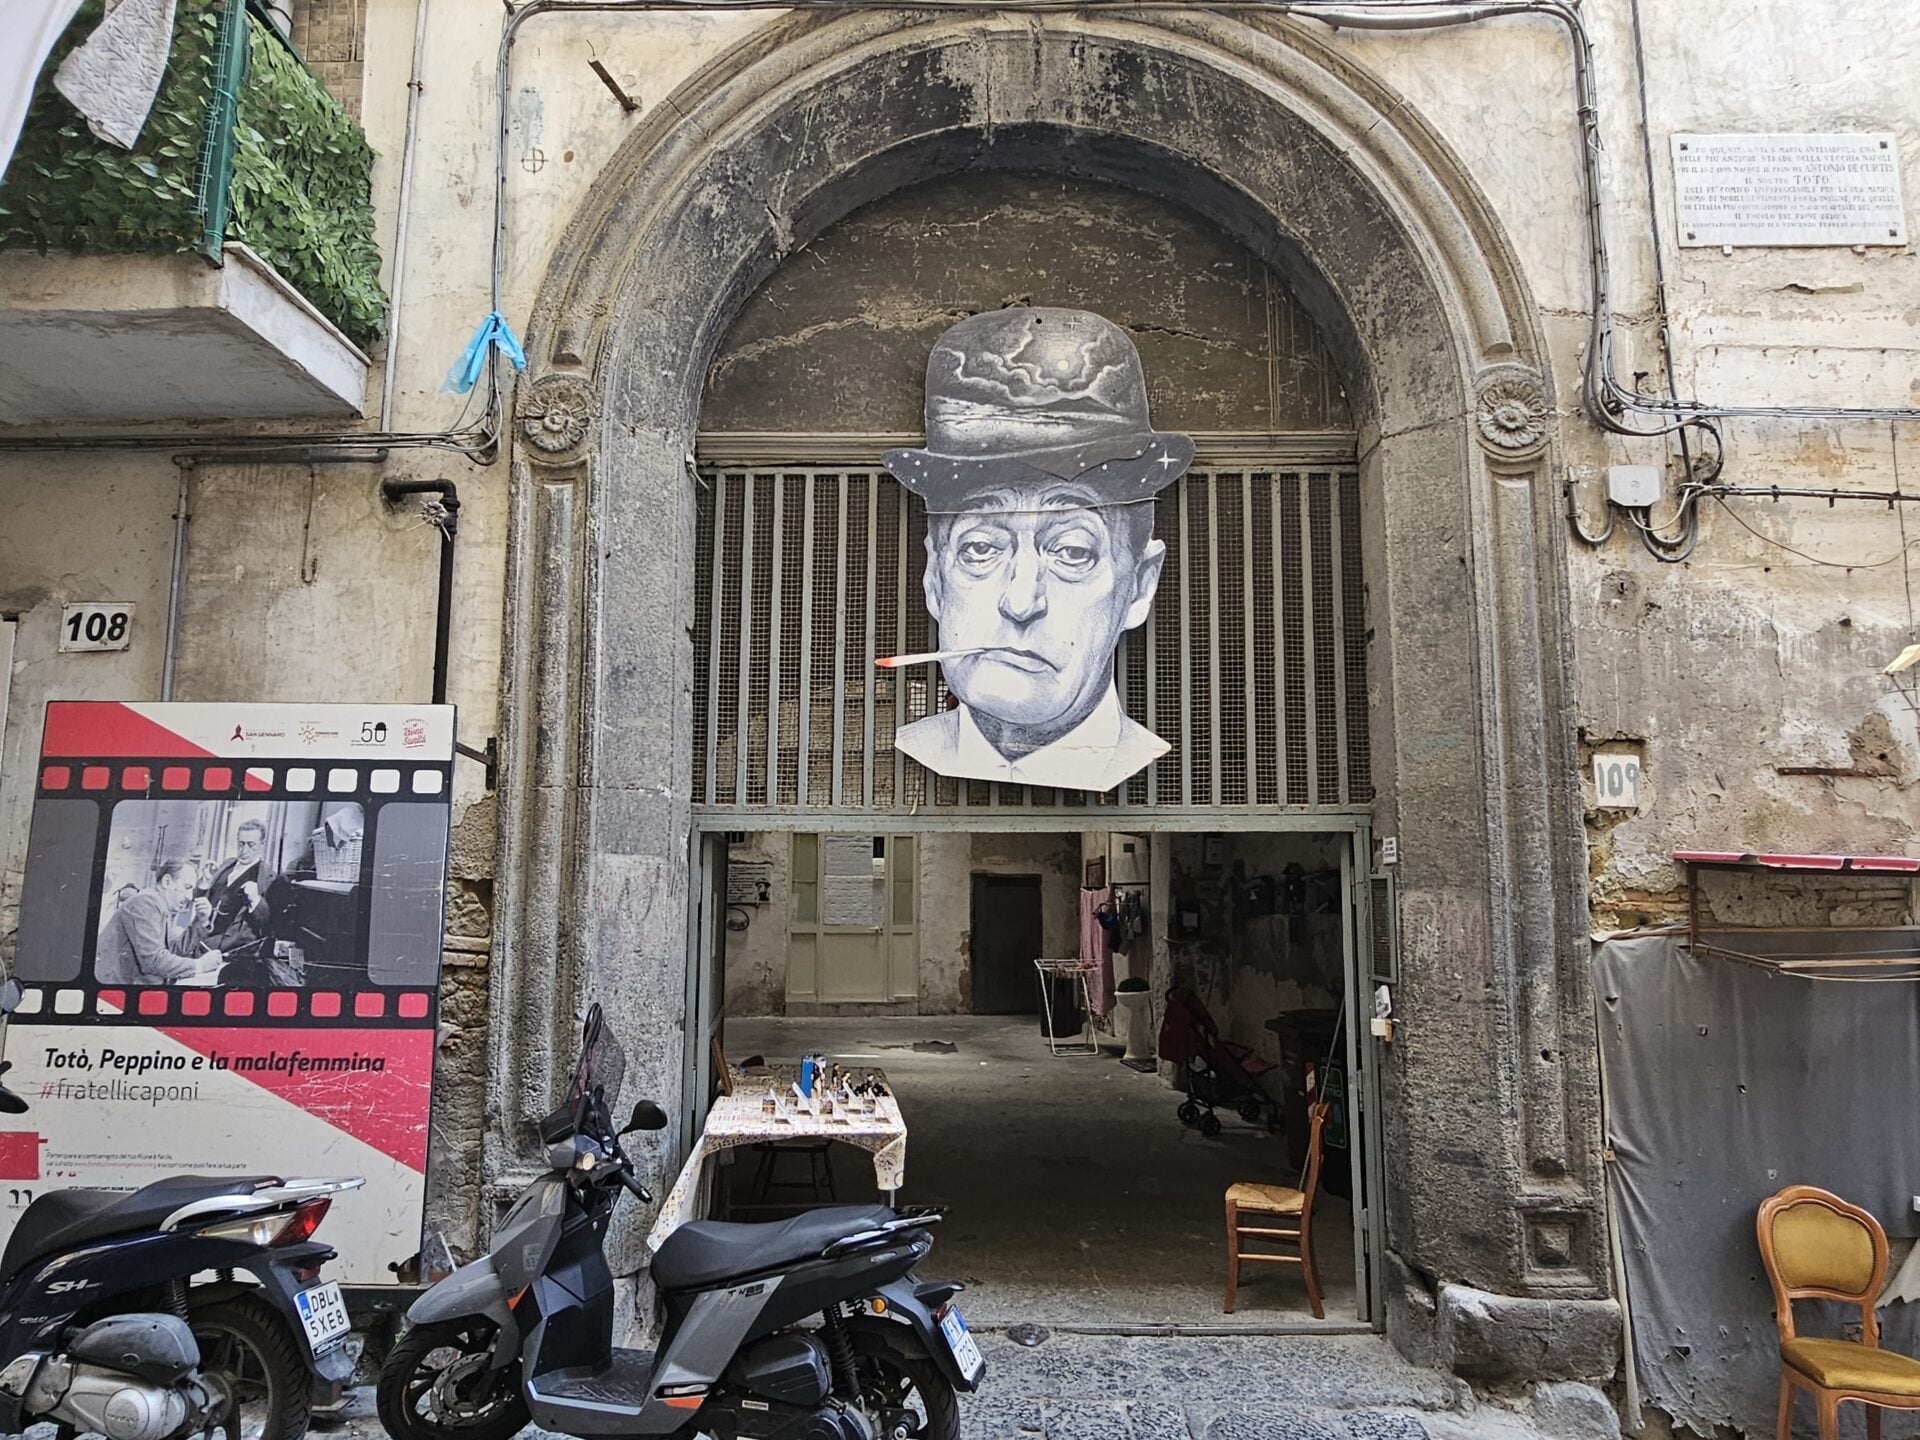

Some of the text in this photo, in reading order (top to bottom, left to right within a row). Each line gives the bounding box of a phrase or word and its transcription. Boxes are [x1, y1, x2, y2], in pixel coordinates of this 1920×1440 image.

[67, 612, 129, 642] 108
[1597, 761, 1640, 801] 109
[45, 1048, 386, 1077] Totò, Peppino e la malafemmina
[40, 1078, 199, 1107] #fratellicaponi
[45, 1279, 88, 1294] SH
[311, 1289, 334, 1313] DBL
[310, 1309, 344, 1338] 5XE8
